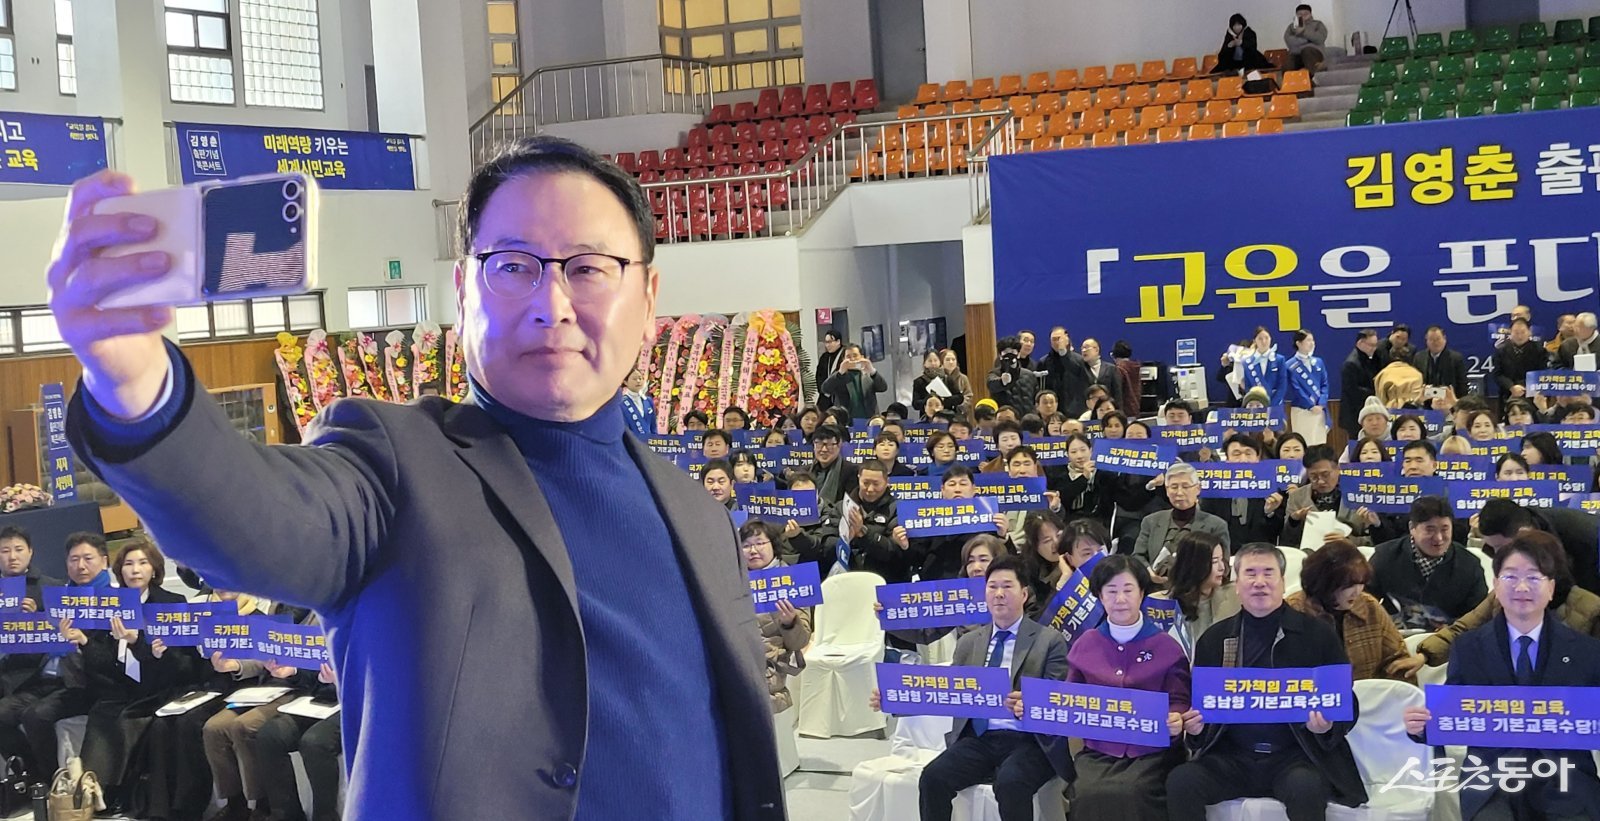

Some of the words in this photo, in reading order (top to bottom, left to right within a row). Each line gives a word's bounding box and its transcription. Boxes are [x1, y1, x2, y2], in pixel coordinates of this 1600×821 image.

[264, 134, 311, 154] 미래역량
[315, 137, 349, 155] 키우는
[5, 149, 39, 171] 교육
[277, 158, 346, 178] 세계시민교육
[1345, 144, 1519, 208] 김영춘
[1534, 142, 1600, 197] 출
[1121, 458, 1169, 470] 기본교육수당!
[1213, 480, 1270, 490] 기본교육수당!
[750, 496, 776, 505] 국가책임
[1470, 488, 1510, 498] 국가책임
[764, 506, 811, 516] 기본교육수당!
[918, 506, 953, 517] 국가책임
[956, 505, 977, 515] 교육,
[905, 517, 932, 529] 충남형
[936, 513, 992, 526] 기본교육수당!
[771, 575, 795, 588] 교육,
[61, 596, 98, 607] 국가책임
[101, 596, 120, 607] 교육,
[900, 590, 943, 604] 국가책임
[948, 588, 973, 602] 교육,
[50, 608, 76, 619] 충남형
[79, 608, 135, 620] 기본교육수당!
[156, 612, 190, 623] 국가책임
[886, 604, 918, 620] 충남형
[923, 601, 988, 617] 기본교육수당
[3, 622, 34, 631] 국가책임
[147, 625, 170, 636] 충남형
[214, 625, 249, 636] 국가책임
[0, 633, 15, 644] 남형
[204, 638, 227, 648] 충남형
[268, 631, 302, 645] 국가책임
[305, 635, 326, 647] 교육
[258, 642, 281, 656] 충남형
[901, 675, 949, 690] 국가책임
[954, 677, 981, 691] 교육,
[1224, 679, 1280, 693] 국가책임
[1286, 678, 1318, 694] 교육,
[886, 688, 921, 703] 충남형
[925, 690, 1003, 707] 기본교육수당!
[1049, 691, 1101, 711] 국가책임
[1105, 698, 1137, 715] 교육,
[1203, 695, 1245, 710] 충남형
[1250, 693, 1341, 710] 기본교육수당!
[1461, 698, 1525, 715] 국가책임
[1531, 700, 1570, 717] 교육,
[1030, 706, 1069, 723] 충남형
[1073, 710, 1158, 734] 기본교육수당!
[1438, 715, 1488, 732] 충남형
[1492, 716, 1597, 735] 기본교육수당!
